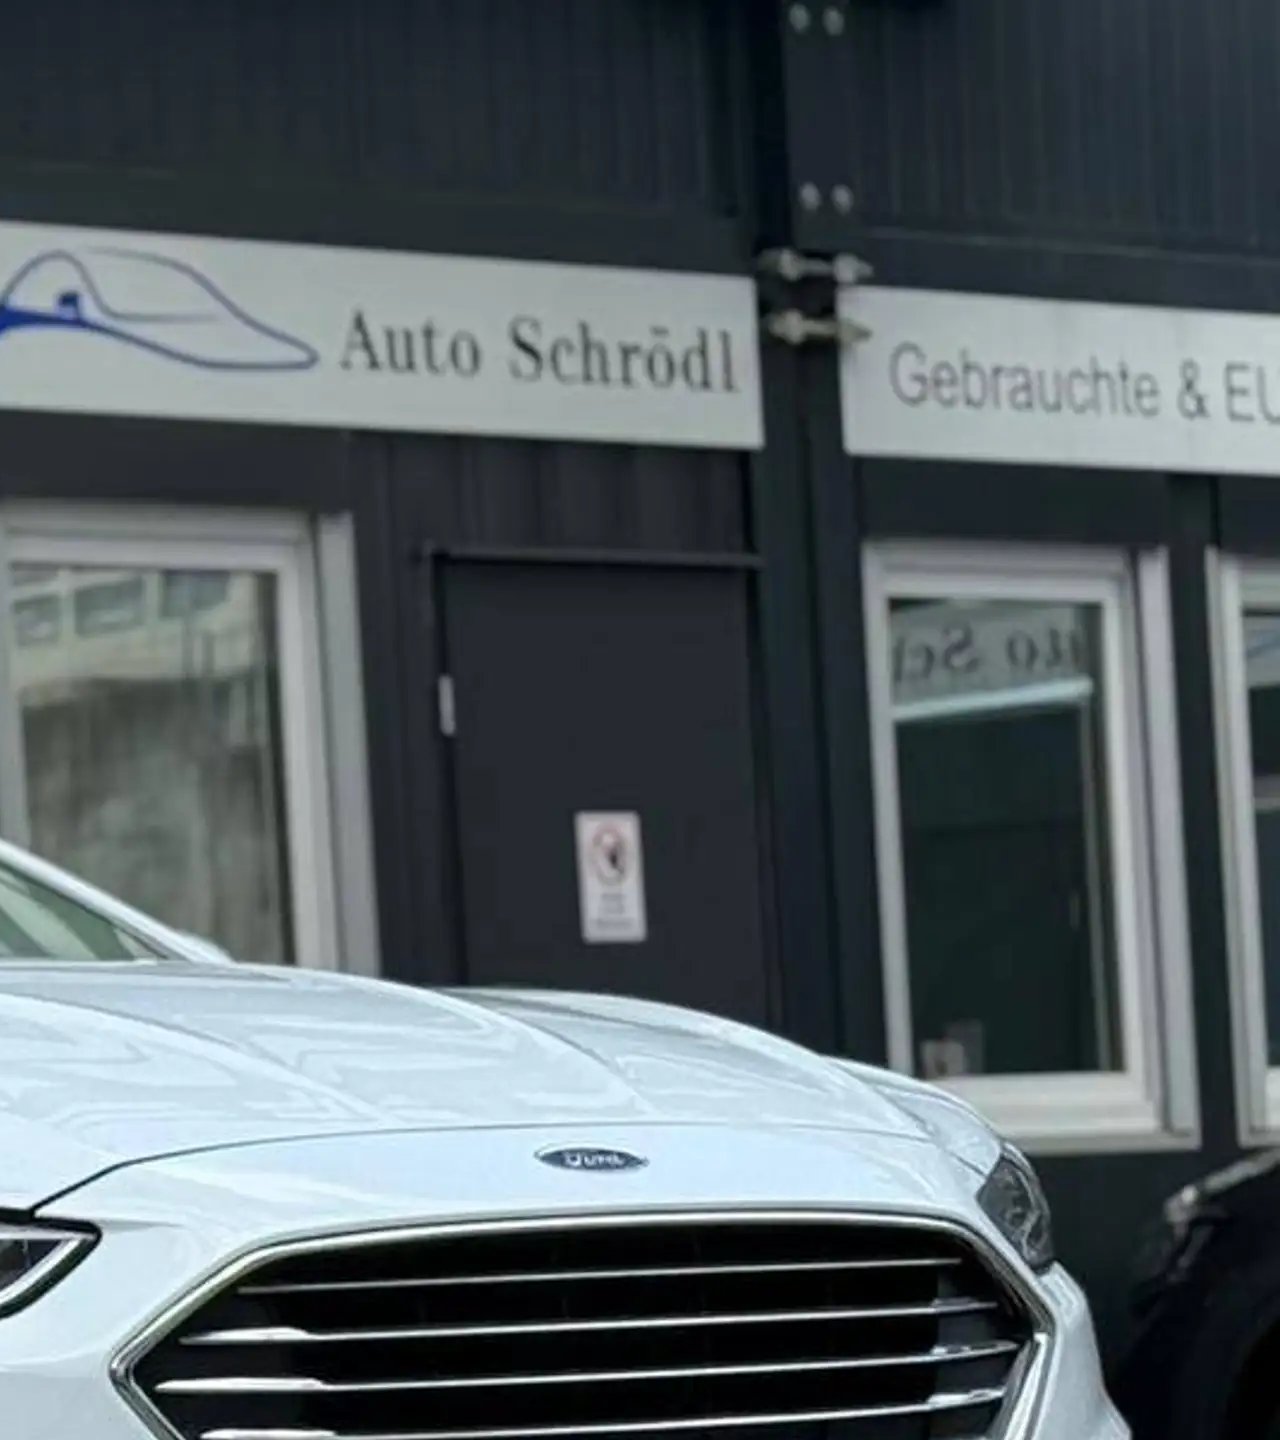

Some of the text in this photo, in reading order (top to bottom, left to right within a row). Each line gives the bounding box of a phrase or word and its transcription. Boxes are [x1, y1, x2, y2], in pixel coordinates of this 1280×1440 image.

[340, 311, 740, 393] Auto Schrödl
[889, 341, 1160, 418] Gebrauchte
[1177, 359, 1210, 420] &
